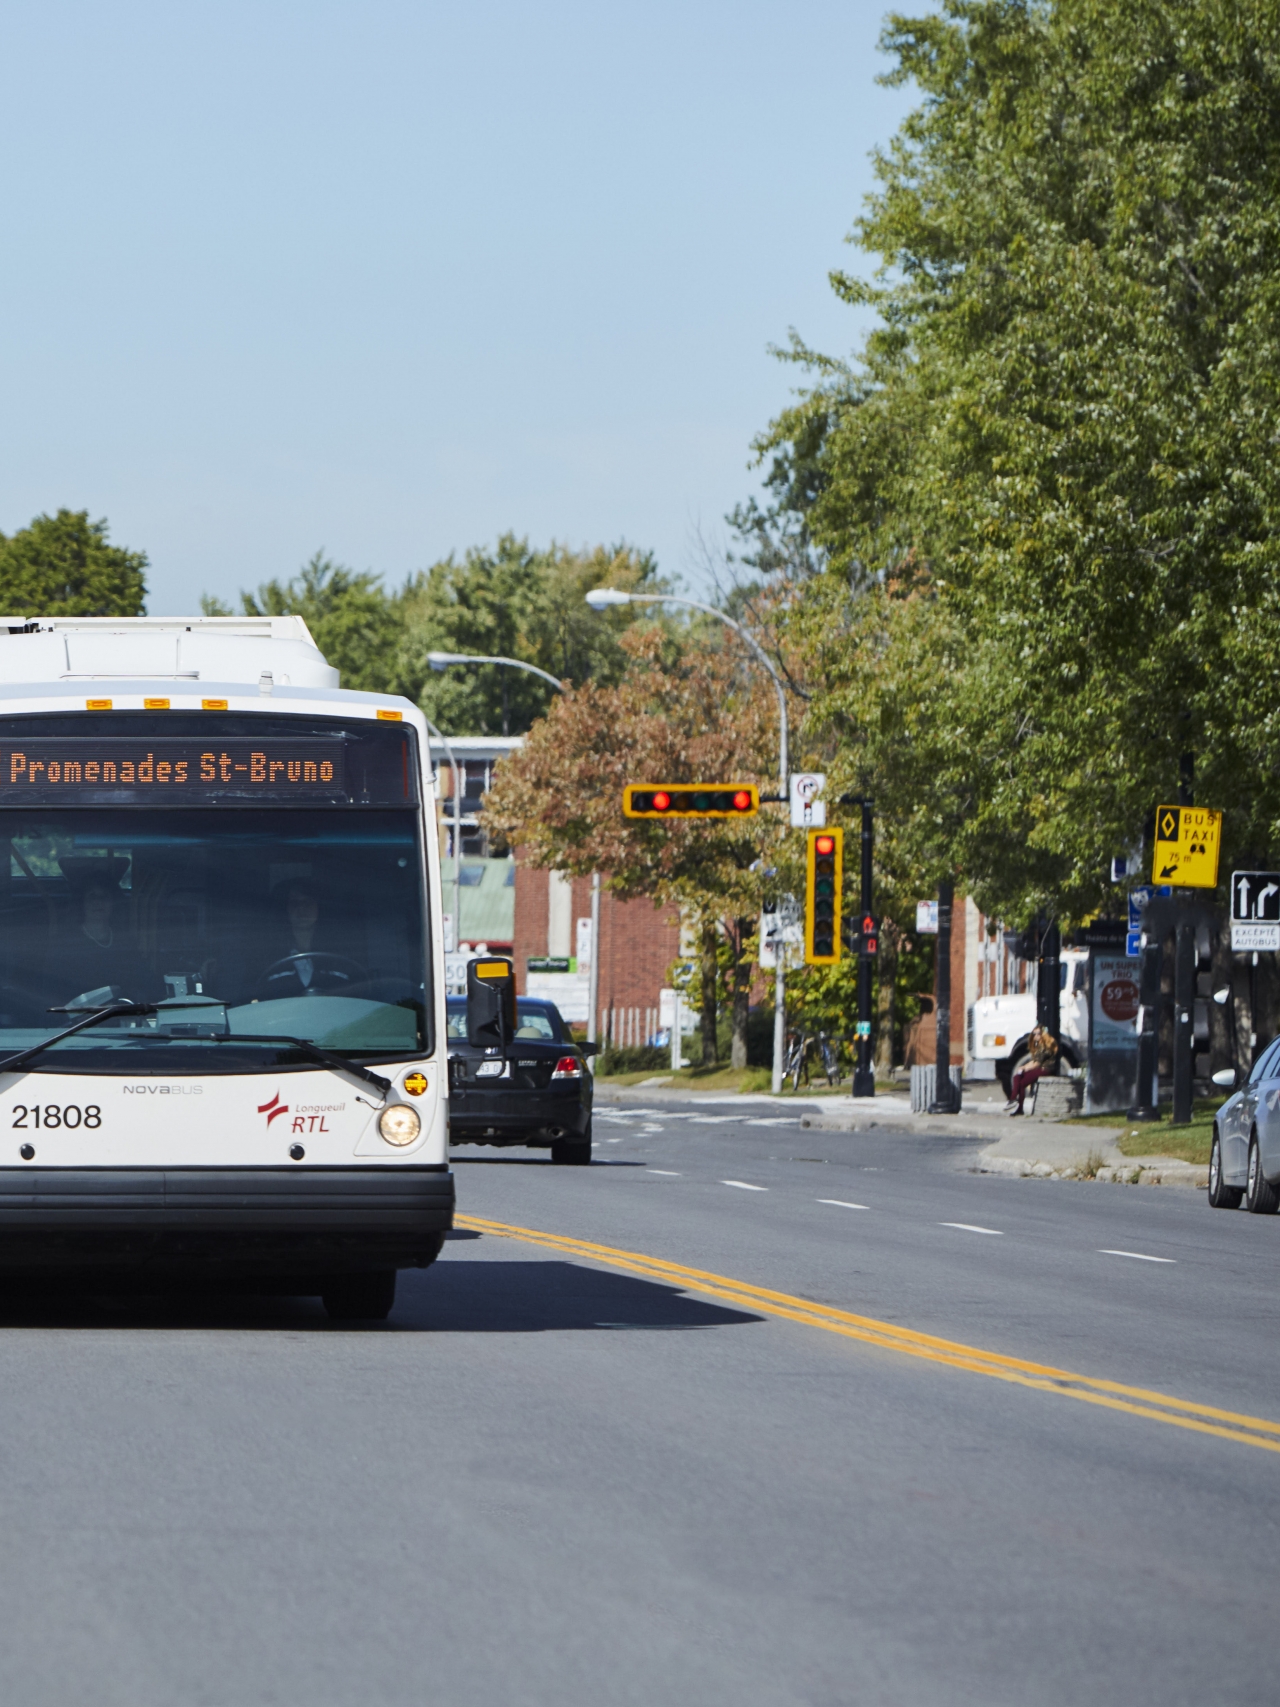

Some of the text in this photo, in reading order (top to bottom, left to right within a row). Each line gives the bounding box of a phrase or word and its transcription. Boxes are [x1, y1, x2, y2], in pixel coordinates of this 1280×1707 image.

[10, 753, 188, 782] Promenades
[200, 752, 333, 782] St-Bruno
[1184, 814, 1215, 826] BUS
[1183, 830, 1214, 842] TAXI
[1169, 852, 1191, 863] 75 m
[1235, 938, 1278, 947] AUTOBUS
[446, 964, 466, 980] 50
[295, 1102, 346, 1114] Longueuil
[11, 1104, 102, 1129] 21808
[290, 1115, 329, 1133] RTL
